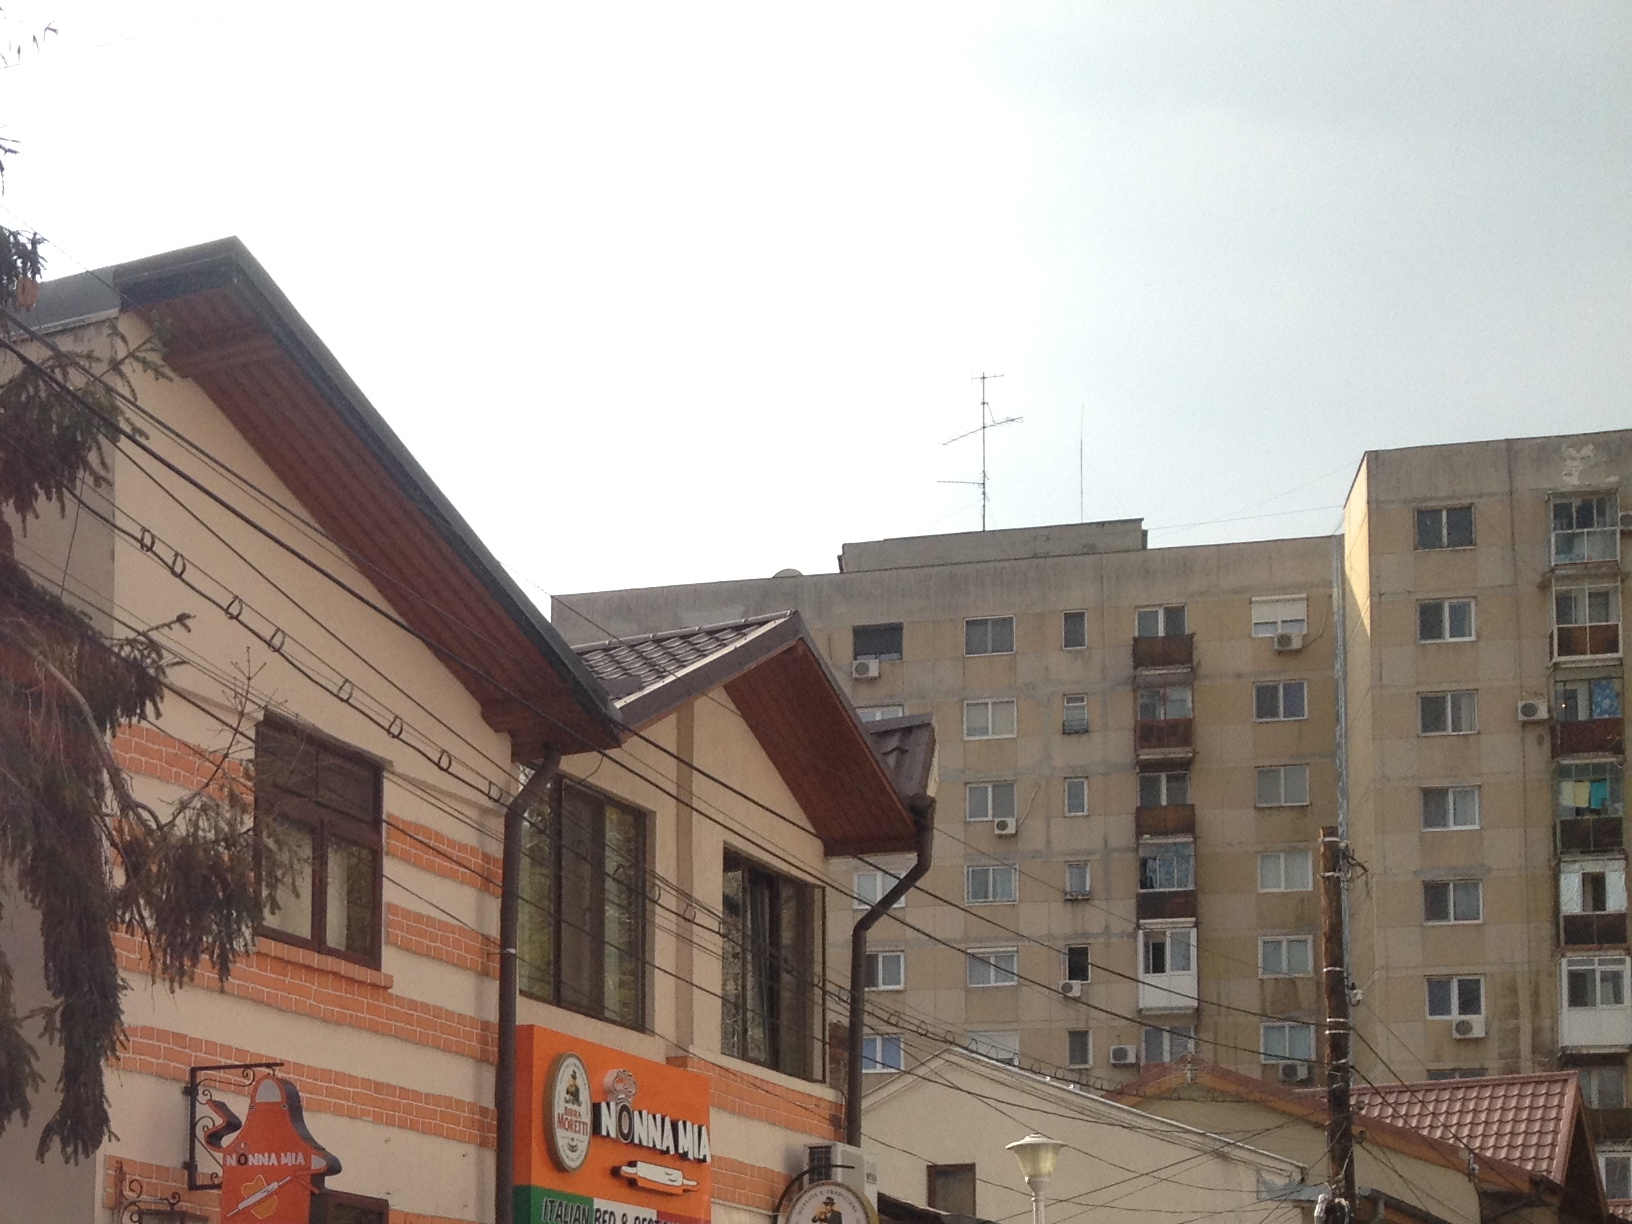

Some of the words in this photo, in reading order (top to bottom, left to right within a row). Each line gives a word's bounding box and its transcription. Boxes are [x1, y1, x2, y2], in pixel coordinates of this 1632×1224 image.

[564, 1105, 582, 1119] BIRRA
[557, 1113, 588, 1135] MORETTI
[600, 1101, 675, 1155] NONNA
[678, 1119, 711, 1163] MIA
[226, 1152, 278, 1166] NONNA
[281, 1152, 305, 1166] MIA
